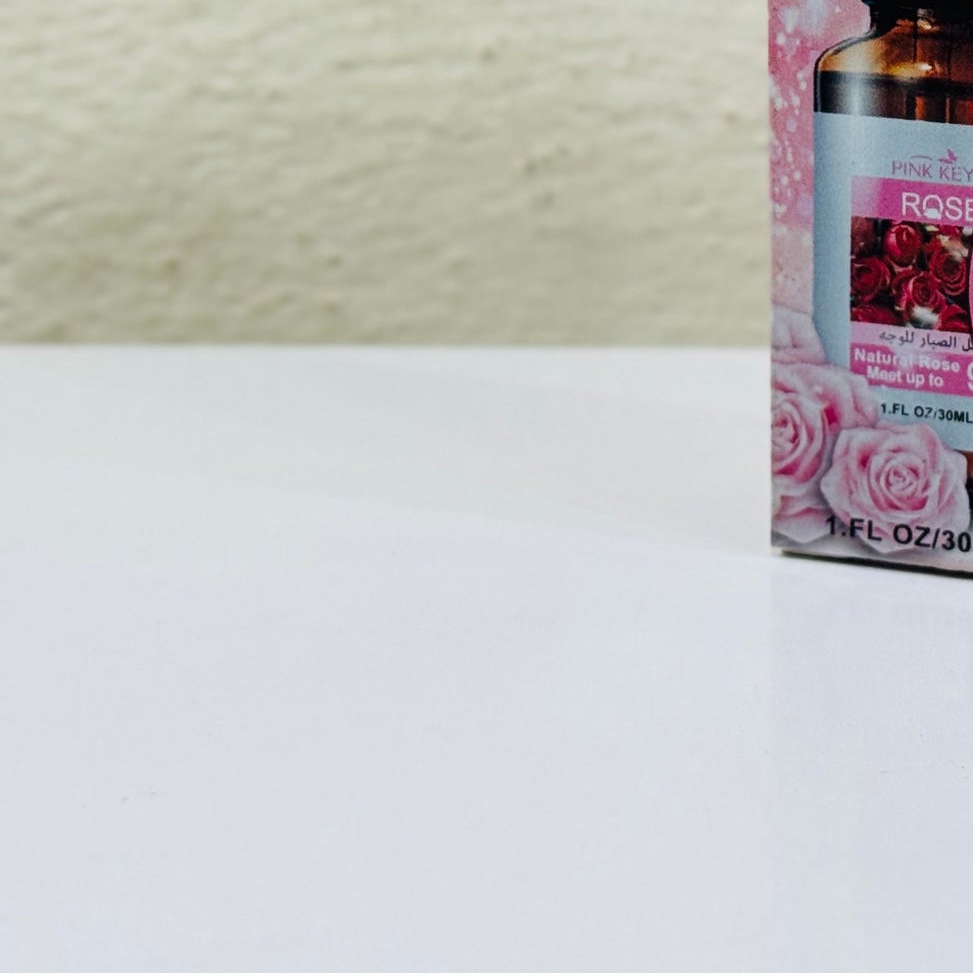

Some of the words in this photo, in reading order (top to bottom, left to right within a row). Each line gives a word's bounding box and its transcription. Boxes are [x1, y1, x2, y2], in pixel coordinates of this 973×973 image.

[891, 160, 933, 179] PINK
[920, 333, 957, 350] الصبار
[854, 348, 913, 366] Natural
[919, 355, 961, 373] Rose
[906, 372, 925, 388] up
[929, 373, 944, 387] to
[914, 405, 973, 424] OZ/30ML
[826, 516, 882, 542] 1.FL
